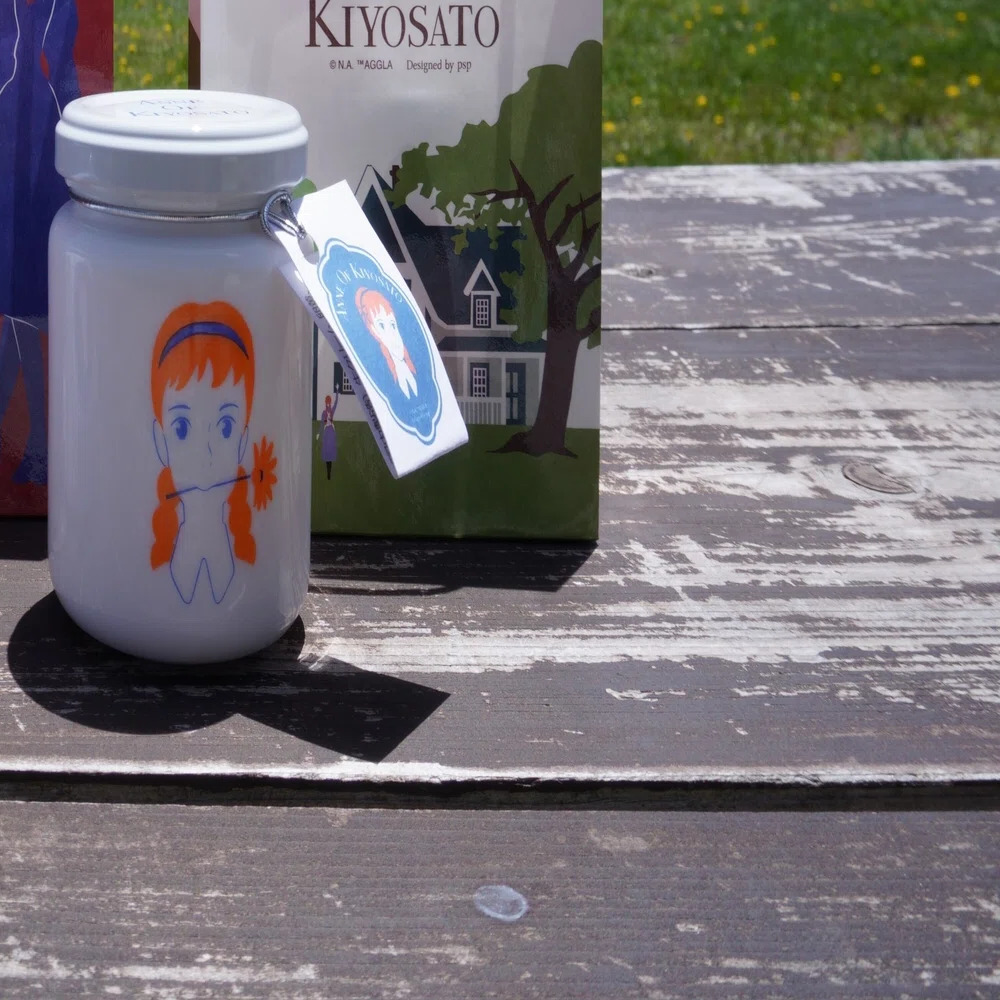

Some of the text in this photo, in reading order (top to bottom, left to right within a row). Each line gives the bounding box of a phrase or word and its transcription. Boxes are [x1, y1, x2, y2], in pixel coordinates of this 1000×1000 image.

[406, 58, 442, 73] Designed
[445, 58, 455, 73] by
[457, 60, 472, 72] psp
